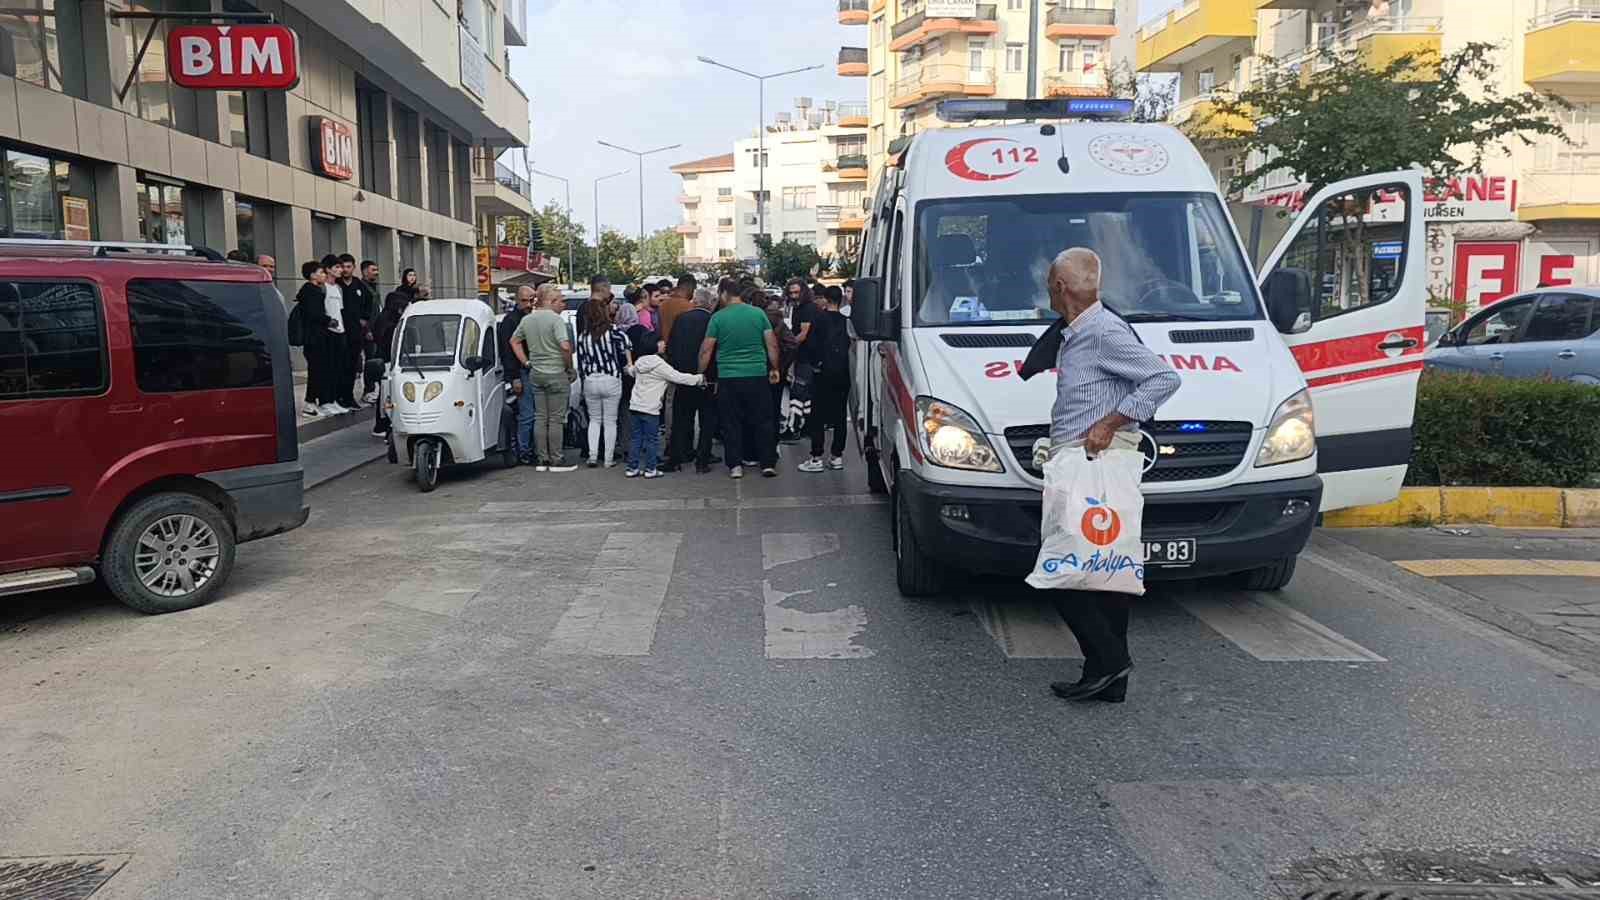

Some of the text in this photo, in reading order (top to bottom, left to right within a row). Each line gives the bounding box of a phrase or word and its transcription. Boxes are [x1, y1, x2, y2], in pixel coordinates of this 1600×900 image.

[180, 26, 283, 76] BİM
[991, 147, 1040, 164] 112
[1167, 541, 1189, 560] 83
